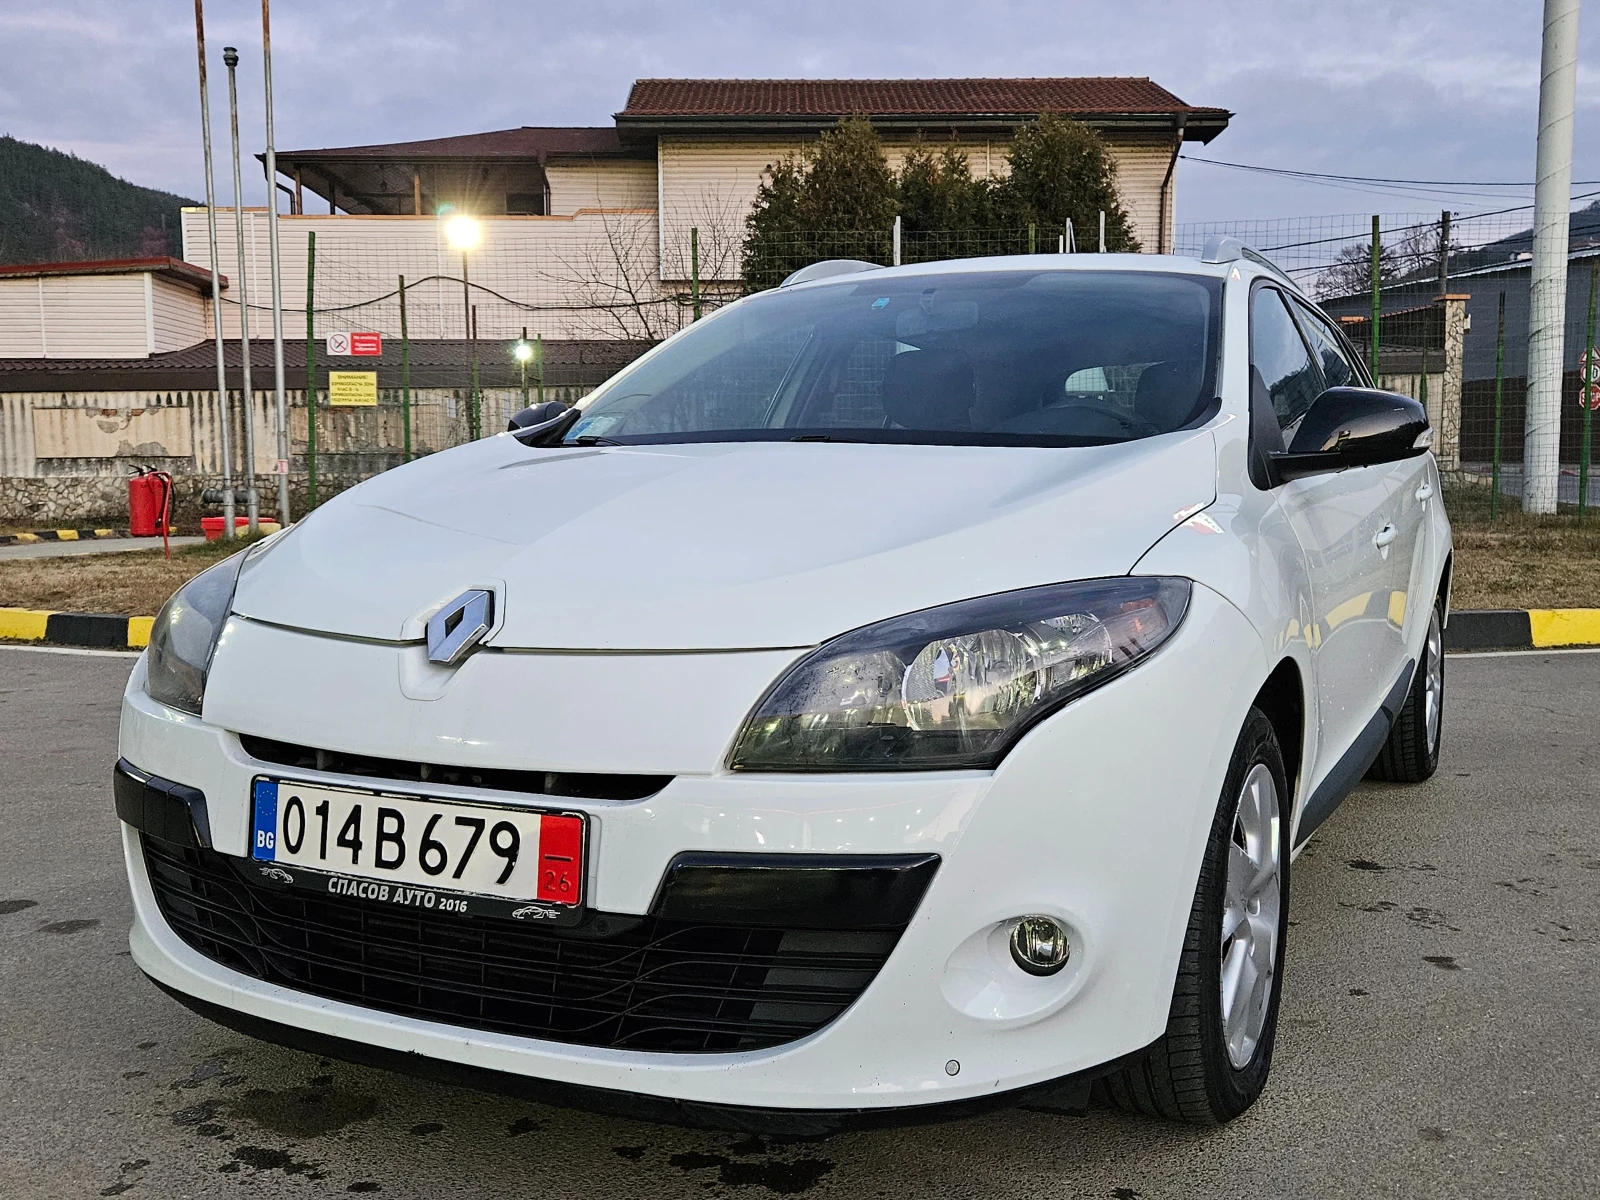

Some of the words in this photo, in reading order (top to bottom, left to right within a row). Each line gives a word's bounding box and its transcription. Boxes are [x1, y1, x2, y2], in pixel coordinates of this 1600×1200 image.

[257, 829, 274, 850] BG
[543, 870, 570, 894] 26
[327, 876, 389, 902] СПАСОВ
[392, 890, 436, 908] АУТО
[438, 898, 468, 913] 2016
